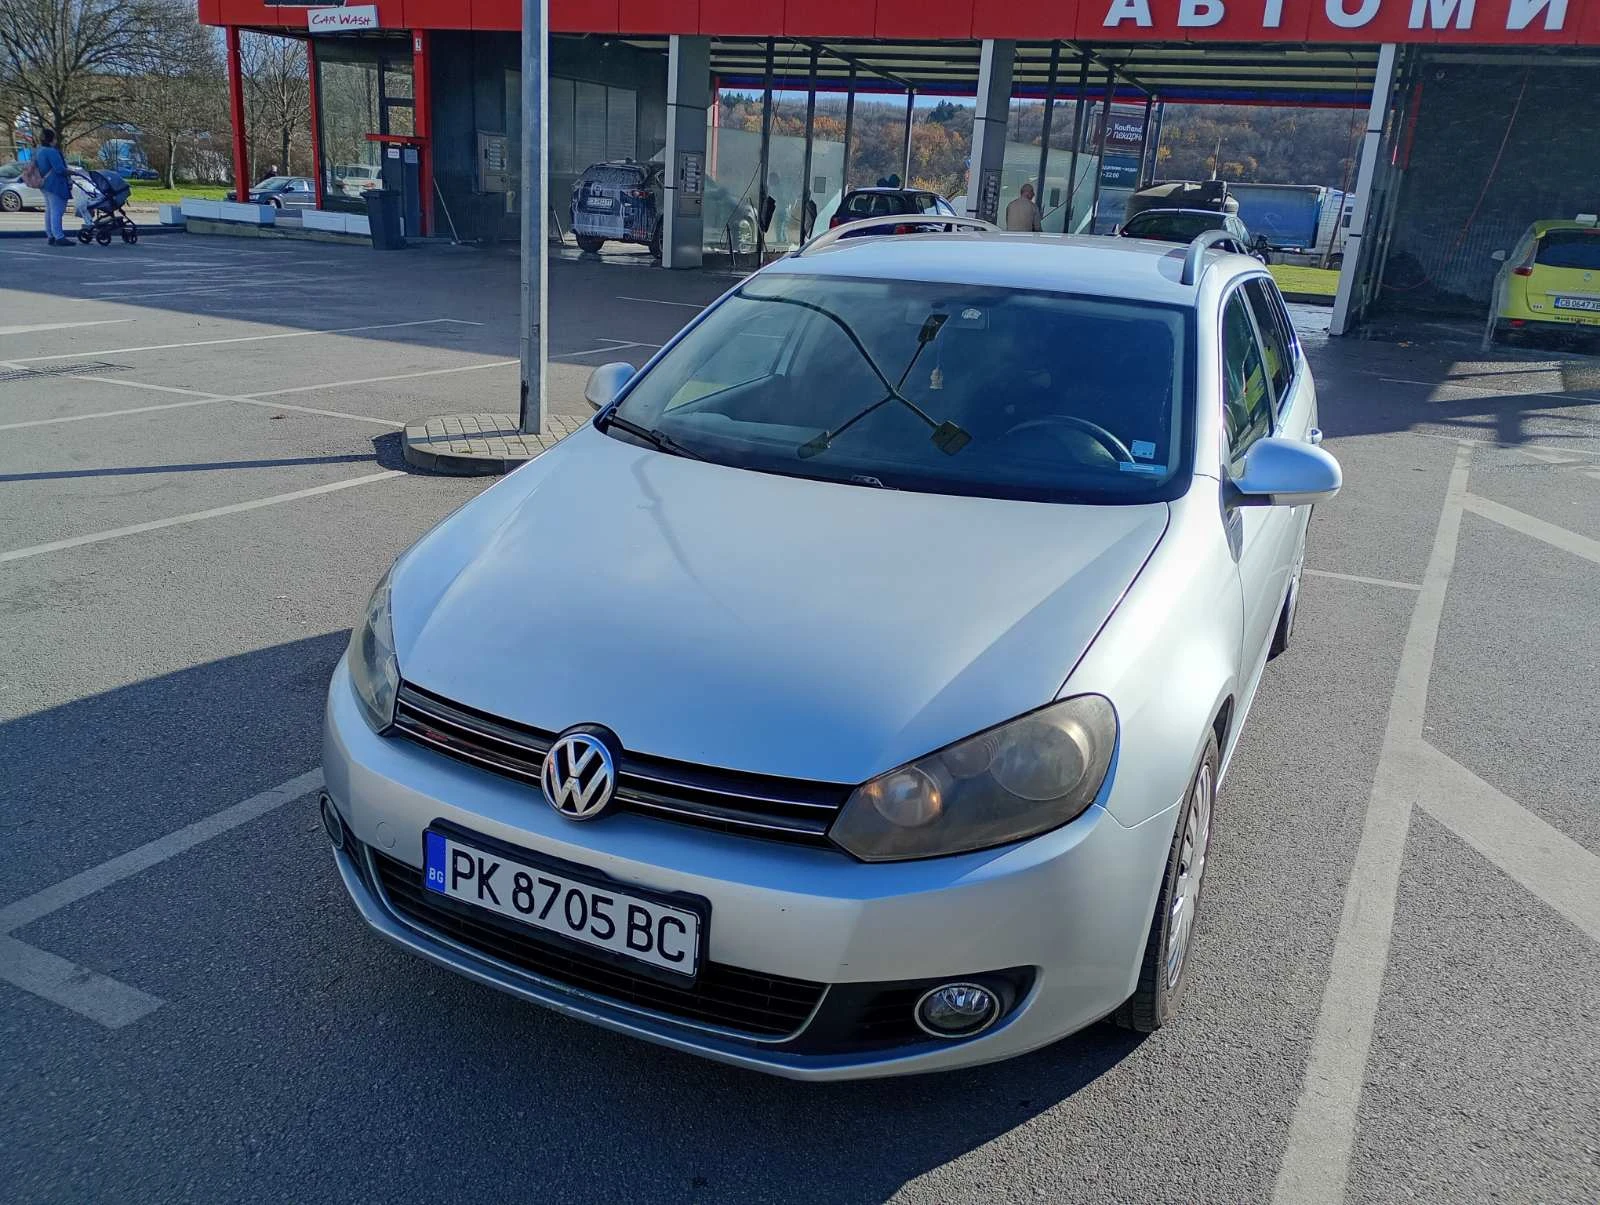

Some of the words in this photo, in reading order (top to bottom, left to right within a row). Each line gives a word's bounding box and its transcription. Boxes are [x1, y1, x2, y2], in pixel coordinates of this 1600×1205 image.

[312, 14, 336, 25] CAR
[339, 14, 372, 26] WASH
[428, 866, 444, 884] BG
[452, 847, 502, 906] PK
[511, 871, 616, 941] 8705
[626, 903, 687, 963] BC
